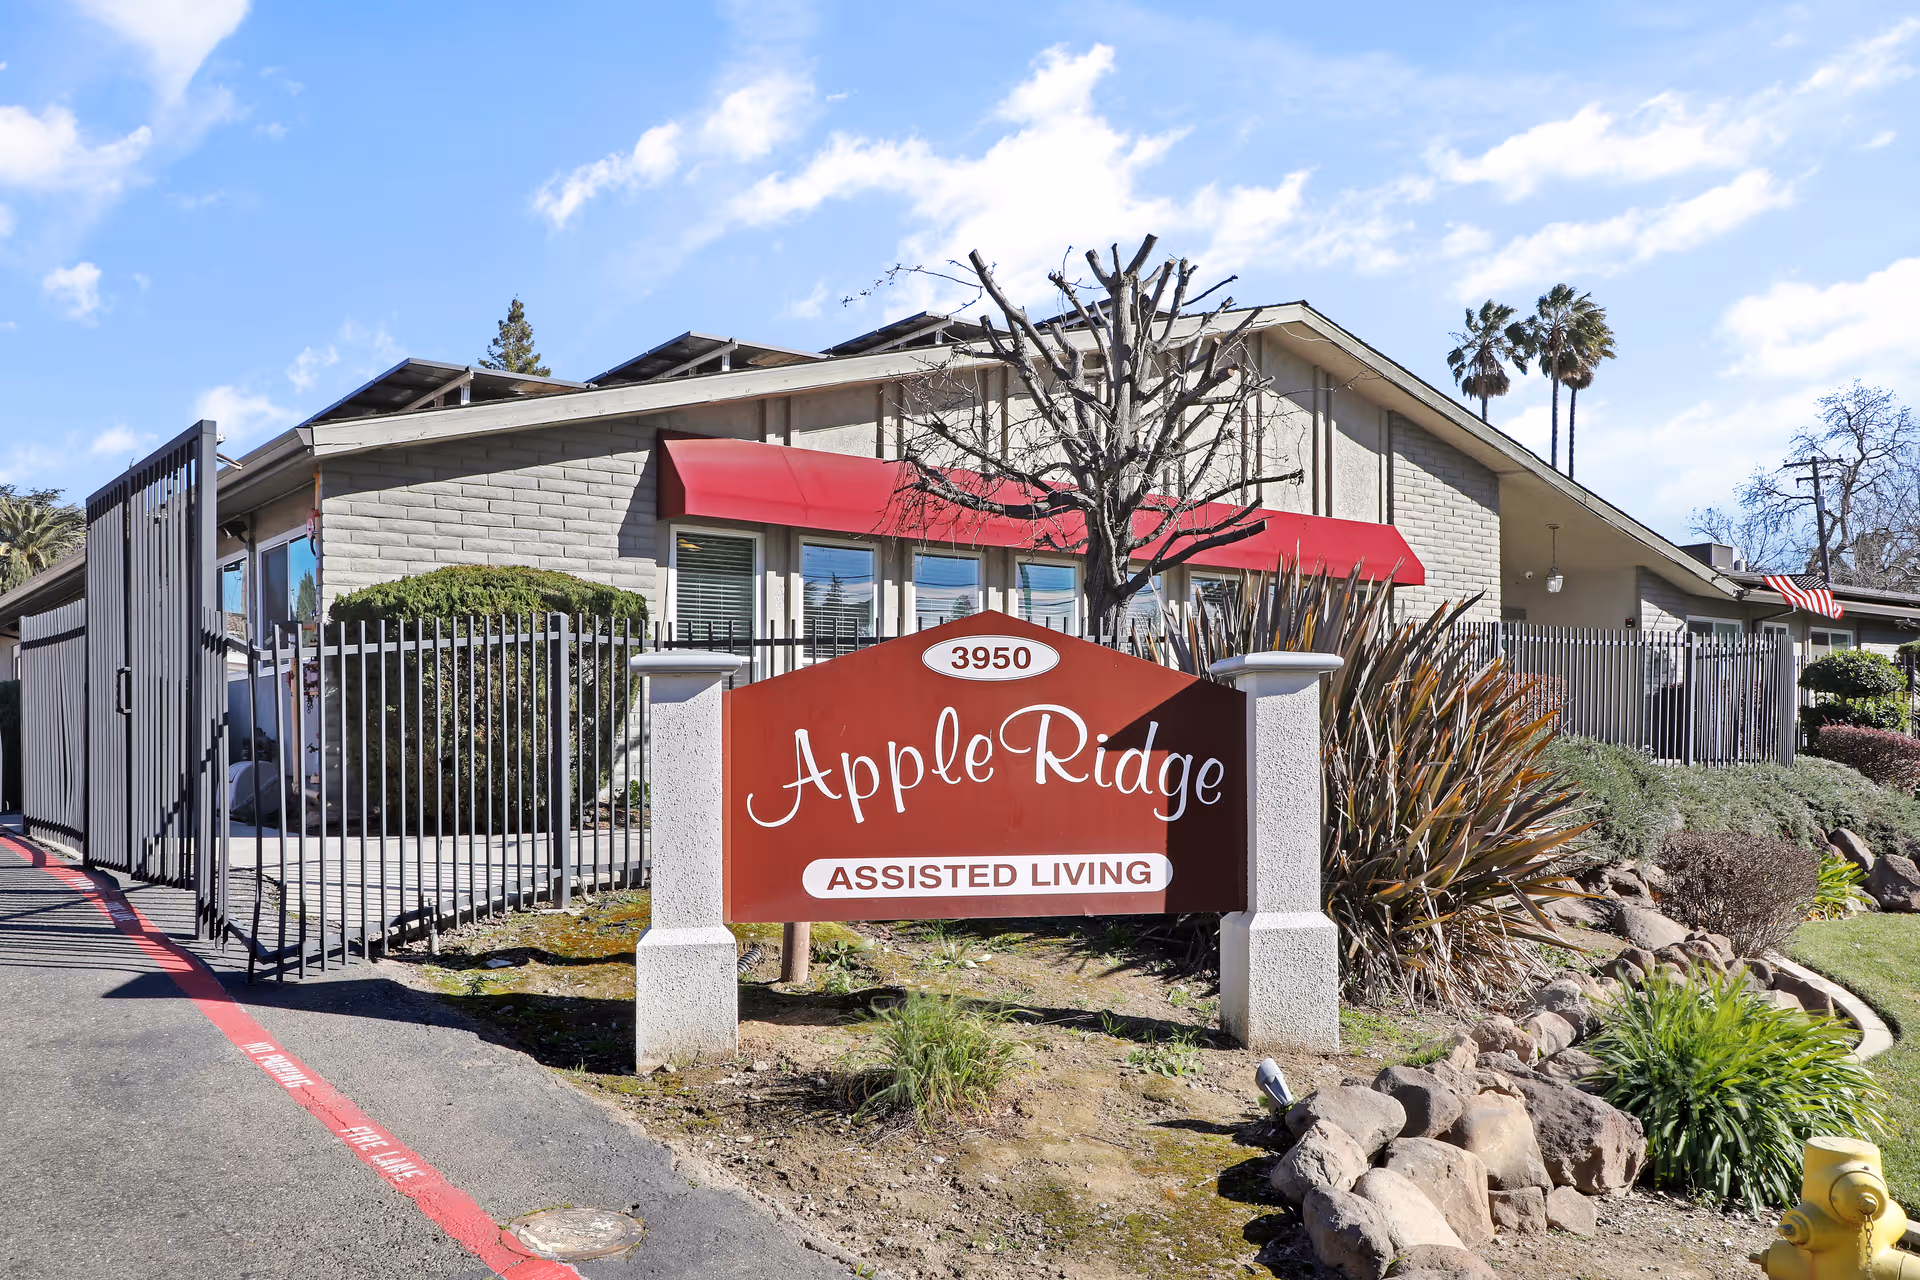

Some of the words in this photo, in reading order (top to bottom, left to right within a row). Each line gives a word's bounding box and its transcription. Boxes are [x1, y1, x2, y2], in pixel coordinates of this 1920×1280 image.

[951, 646, 1031, 670] 3950
[746, 706, 995, 828] Apple
[998, 703, 1224, 822] Ridge
[827, 864, 1017, 891] ASSISTED
[1031, 861, 1151, 887] LIVING
[242, 1041, 276, 1054] NO
[255, 1054, 315, 1088] PARKING
[339, 1126, 389, 1151] FIRE
[370, 1151, 426, 1181] LANE
